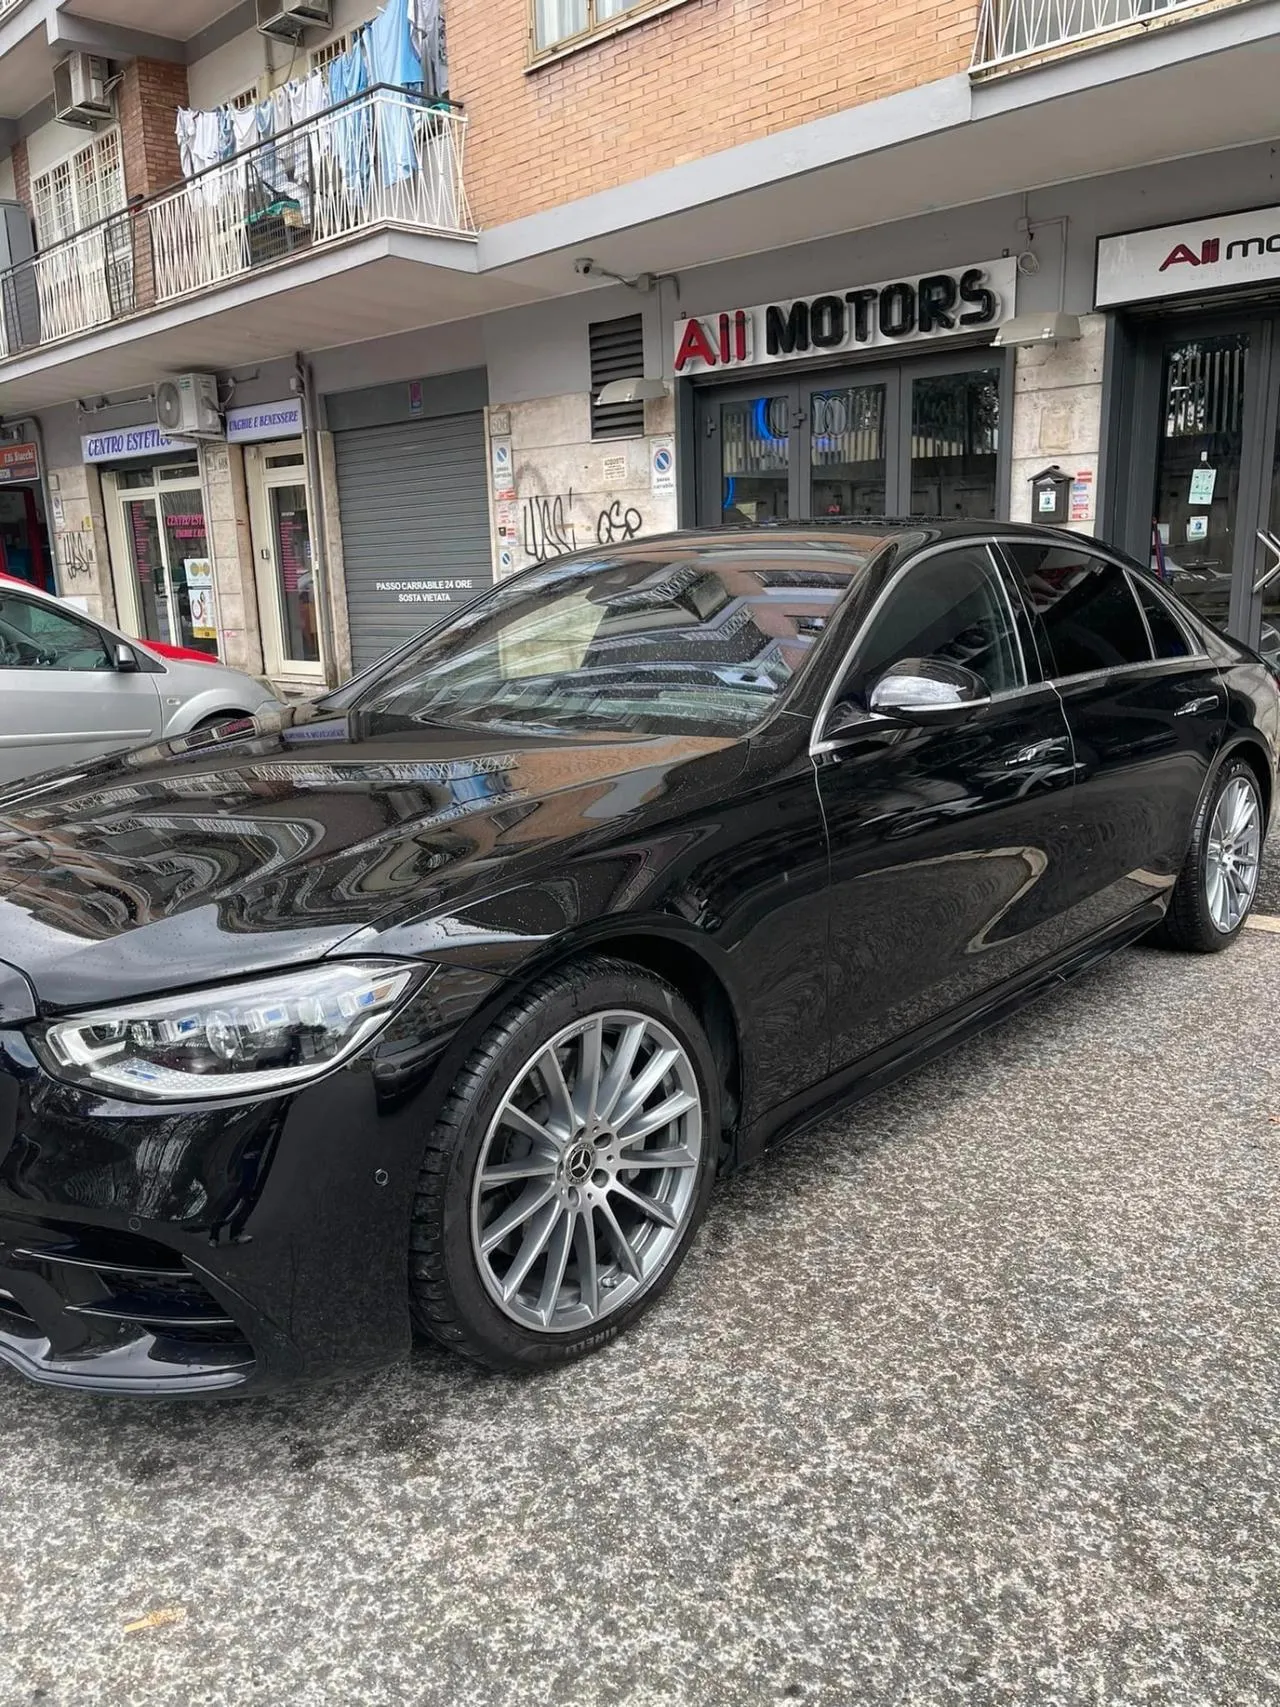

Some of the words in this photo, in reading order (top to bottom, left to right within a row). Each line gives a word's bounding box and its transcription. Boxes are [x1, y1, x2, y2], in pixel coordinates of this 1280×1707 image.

[766, 268, 995, 355] MOTORS
[260, 410, 298, 426] BENESSERE
[88, 434, 124, 457] CENTRO
[375, 582, 401, 591] PASSO
[401, 580, 444, 590] CARRABILE
[444, 580, 454, 589] 24
[454, 579, 473, 589] ORE
[398, 593, 422, 602] SOSTA
[422, 592, 451, 602] VIETATA
